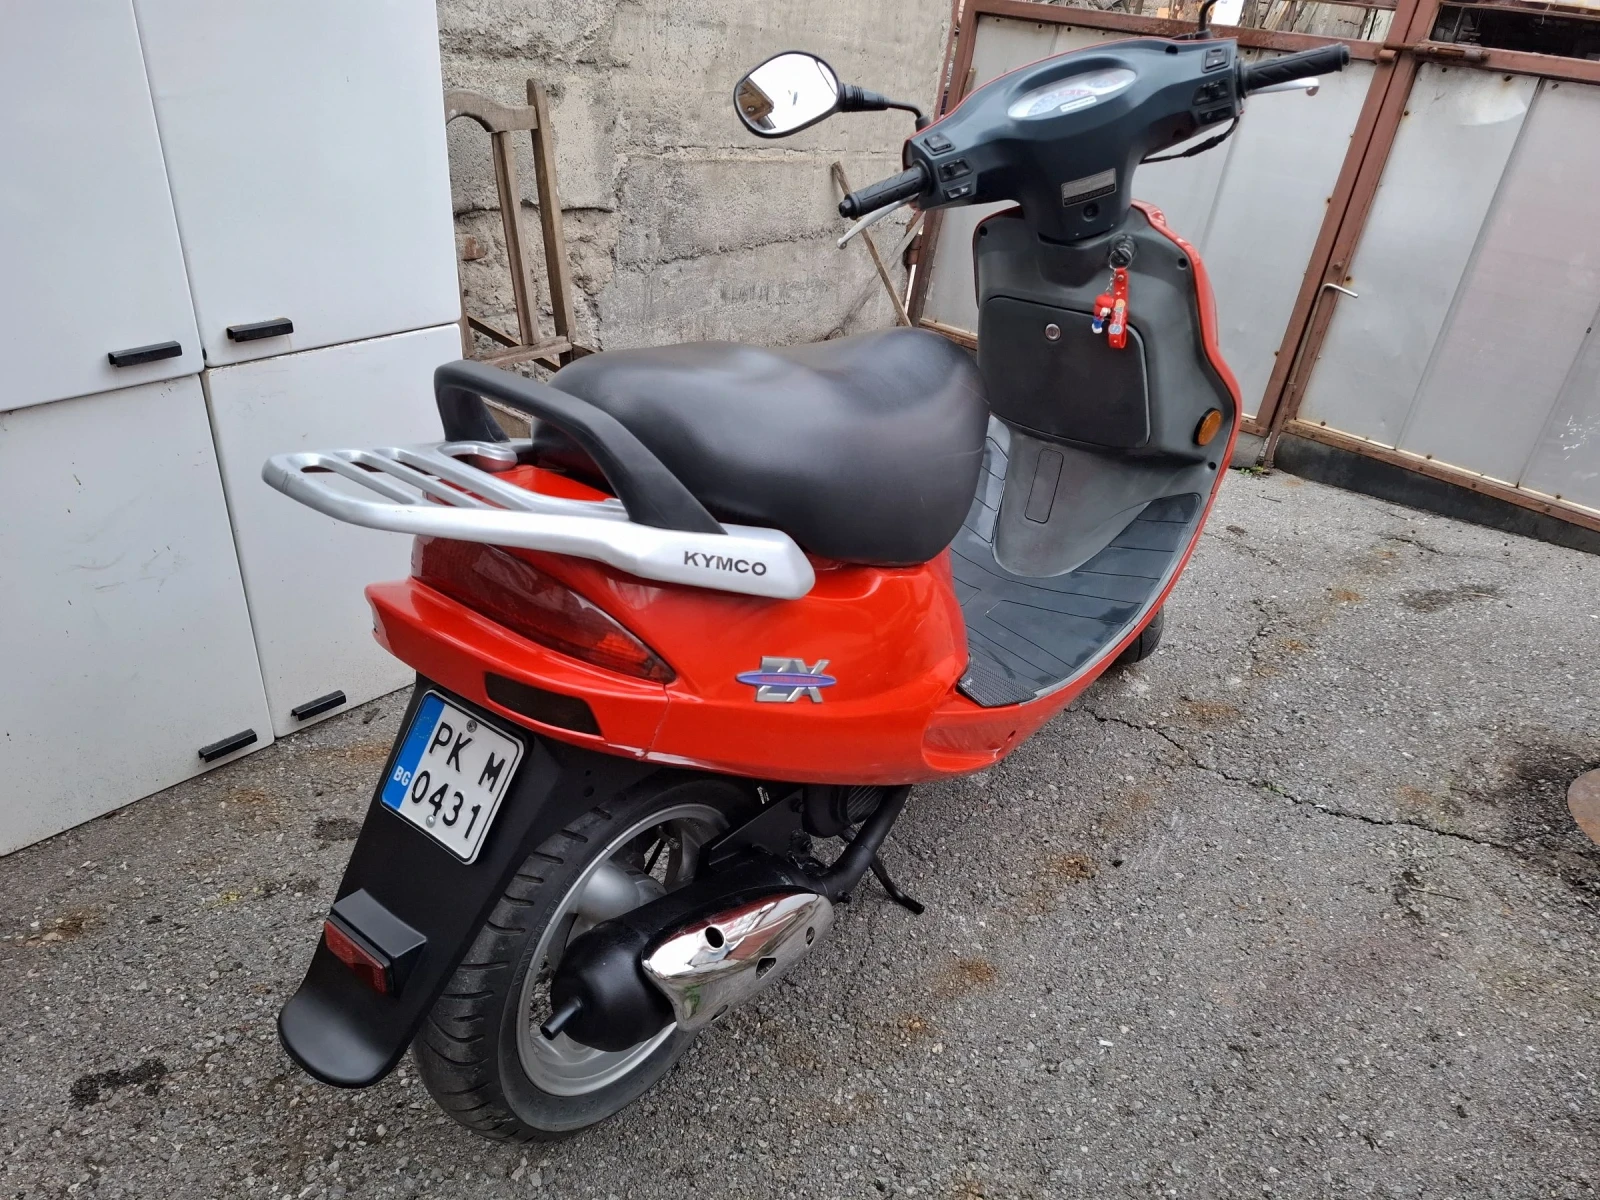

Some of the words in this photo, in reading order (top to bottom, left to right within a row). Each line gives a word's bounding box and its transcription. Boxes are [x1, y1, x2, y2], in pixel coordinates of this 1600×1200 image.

[684, 551, 767, 576] KYMCO
[756, 656, 830, 703] ZX
[393, 766, 412, 787] BG
[428, 721, 473, 773] PK
[478, 751, 506, 793] M
[411, 770, 482, 840] 0431
